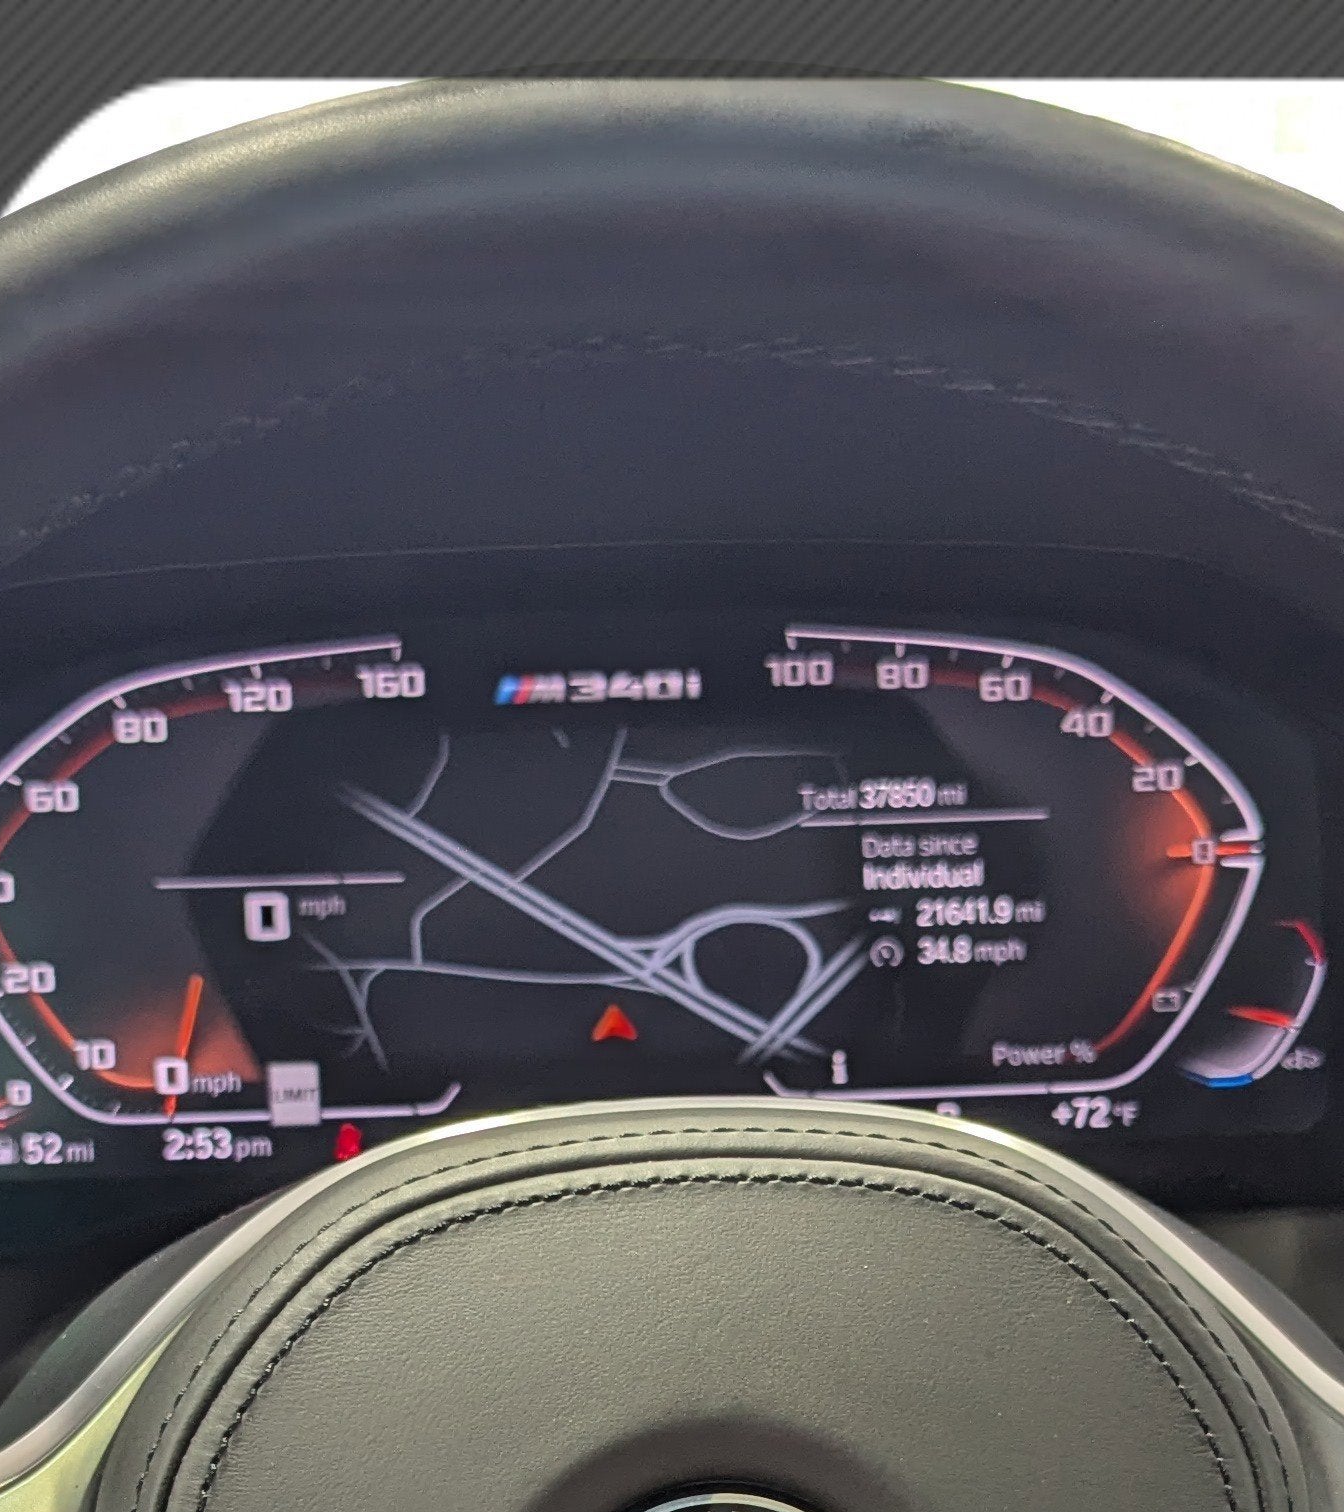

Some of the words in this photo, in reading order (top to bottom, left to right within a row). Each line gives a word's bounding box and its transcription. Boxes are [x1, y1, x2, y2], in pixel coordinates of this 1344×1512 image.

[358, 663, 425, 697] 160
[766, 652, 833, 688] 100
[876, 655, 928, 690] 80
[980, 667, 1030, 701] 60
[226, 680, 292, 711] 120
[496, 668, 702, 706] M340i
[115, 711, 166, 744] 80
[1060, 706, 1113, 738] 40
[799, 785, 856, 810] Total
[860, 778, 936, 809] 37850
[938, 785, 967, 805] mi
[1133, 764, 1183, 793] 20
[26, 783, 78, 813] 60
[862, 833, 915, 858] Data
[918, 833, 978, 857] since
[1191, 842, 1215, 864] 0
[863, 860, 984, 890] Individual
[244, 892, 290, 940] 0
[298, 895, 346, 921] mph
[916, 896, 1014, 926] 21641.9
[1015, 900, 1045, 922] mi
[917, 935, 972, 964] 34.8
[975, 939, 1026, 965] mph
[2, 963, 56, 994] 20
[74, 1042, 116, 1070] 10
[993, 1043, 1065, 1066] Power
[4, 1079, 32, 1107] 0
[156, 1060, 189, 1093] 0
[193, 1073, 242, 1098] mph
[20, 1132, 63, 1165] 52
[65, 1139, 95, 1162] mi
[162, 1129, 232, 1160] 2:53
[234, 1135, 272, 1159] pm
